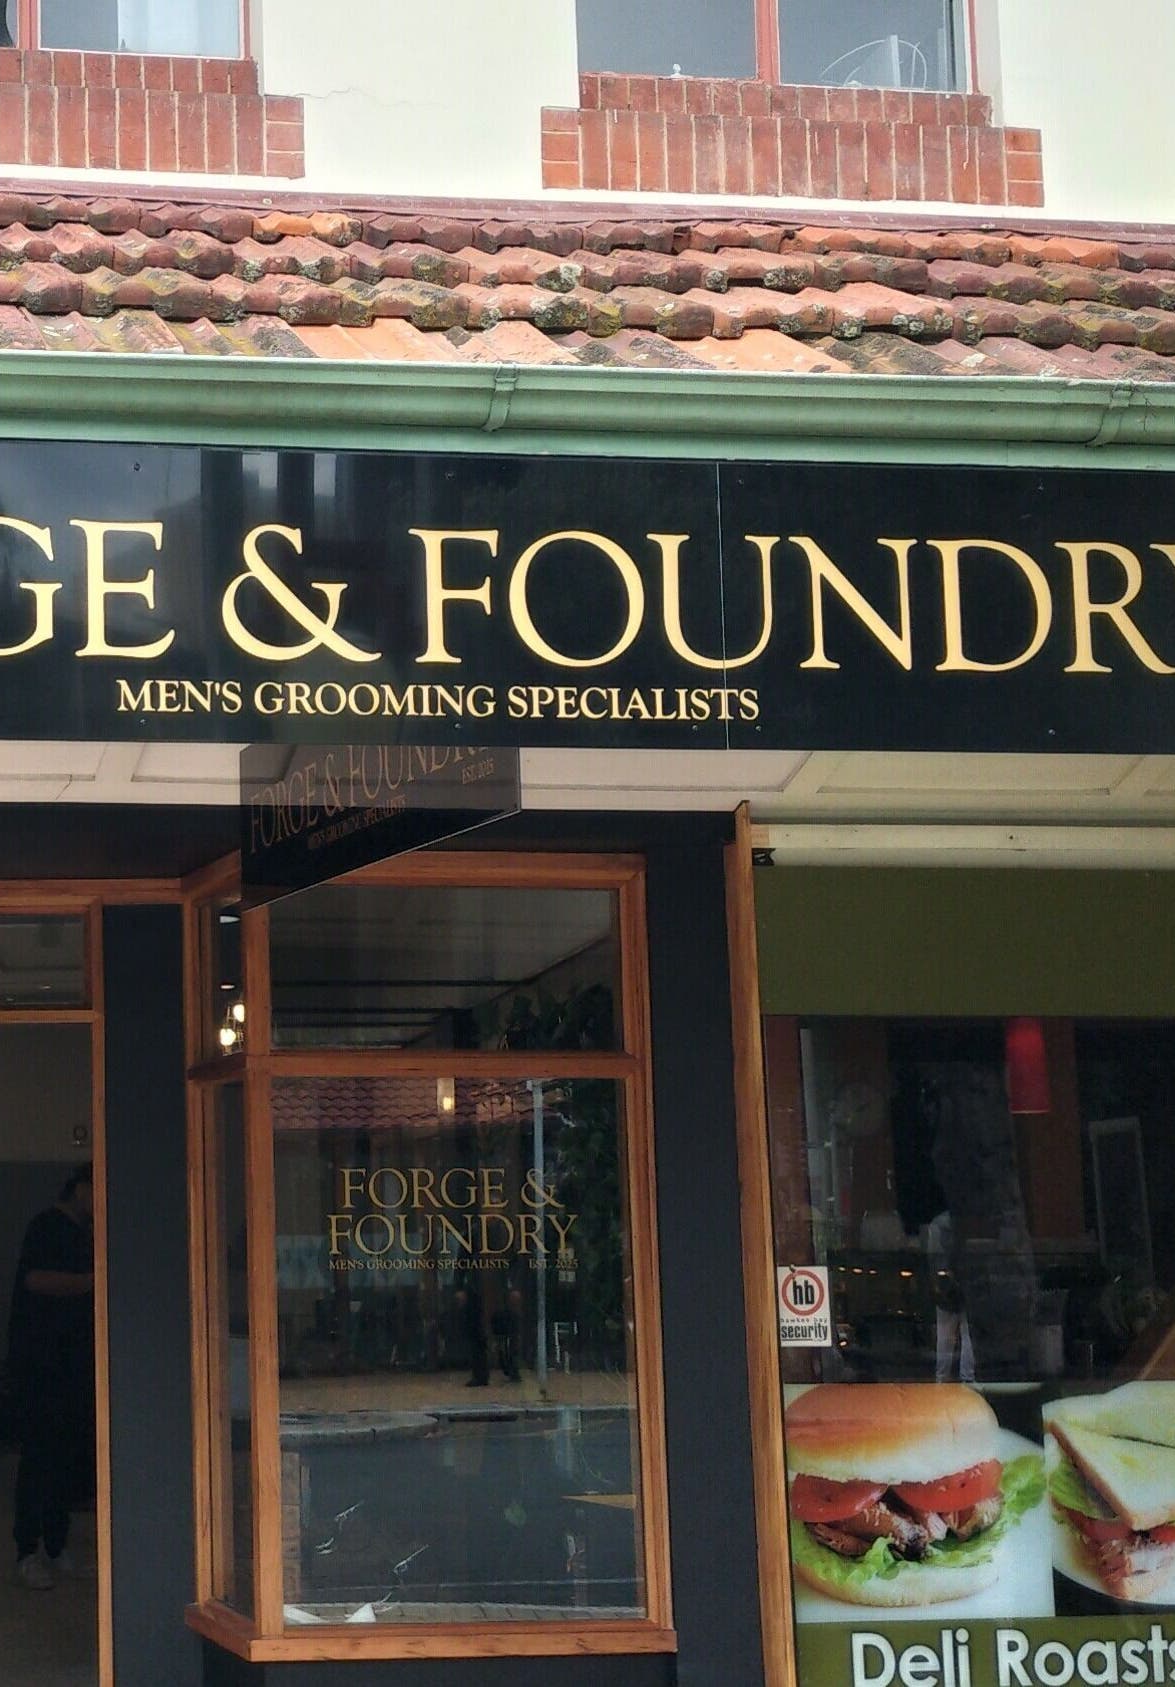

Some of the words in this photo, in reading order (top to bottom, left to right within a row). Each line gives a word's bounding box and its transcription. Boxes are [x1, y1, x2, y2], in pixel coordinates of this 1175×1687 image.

[221, 523, 382, 664] &
[408, 528, 1175, 675] FOUNDR
[116, 679, 243, 714] MEN'S
[253, 682, 496, 718] GROOMING
[507, 686, 760, 722] SPECIALISTS
[249, 763, 319, 854] FORGE
[325, 752, 345, 817] &
[339, 1167, 509, 1209] FORGE
[520, 1167, 565, 1209] &
[327, 1213, 578, 1256] FOUNDRY
[328, 1258, 364, 1271] MEN'S
[367, 1258, 435, 1270] GROOMING
[437, 1258, 510, 1270] SPECIALISTS
[792, 1279, 815, 1305] hb
[781, 1322, 828, 1341] security
[851, 1627, 970, 1687] Deli
[995, 1624, 1175, 1687] Roast
